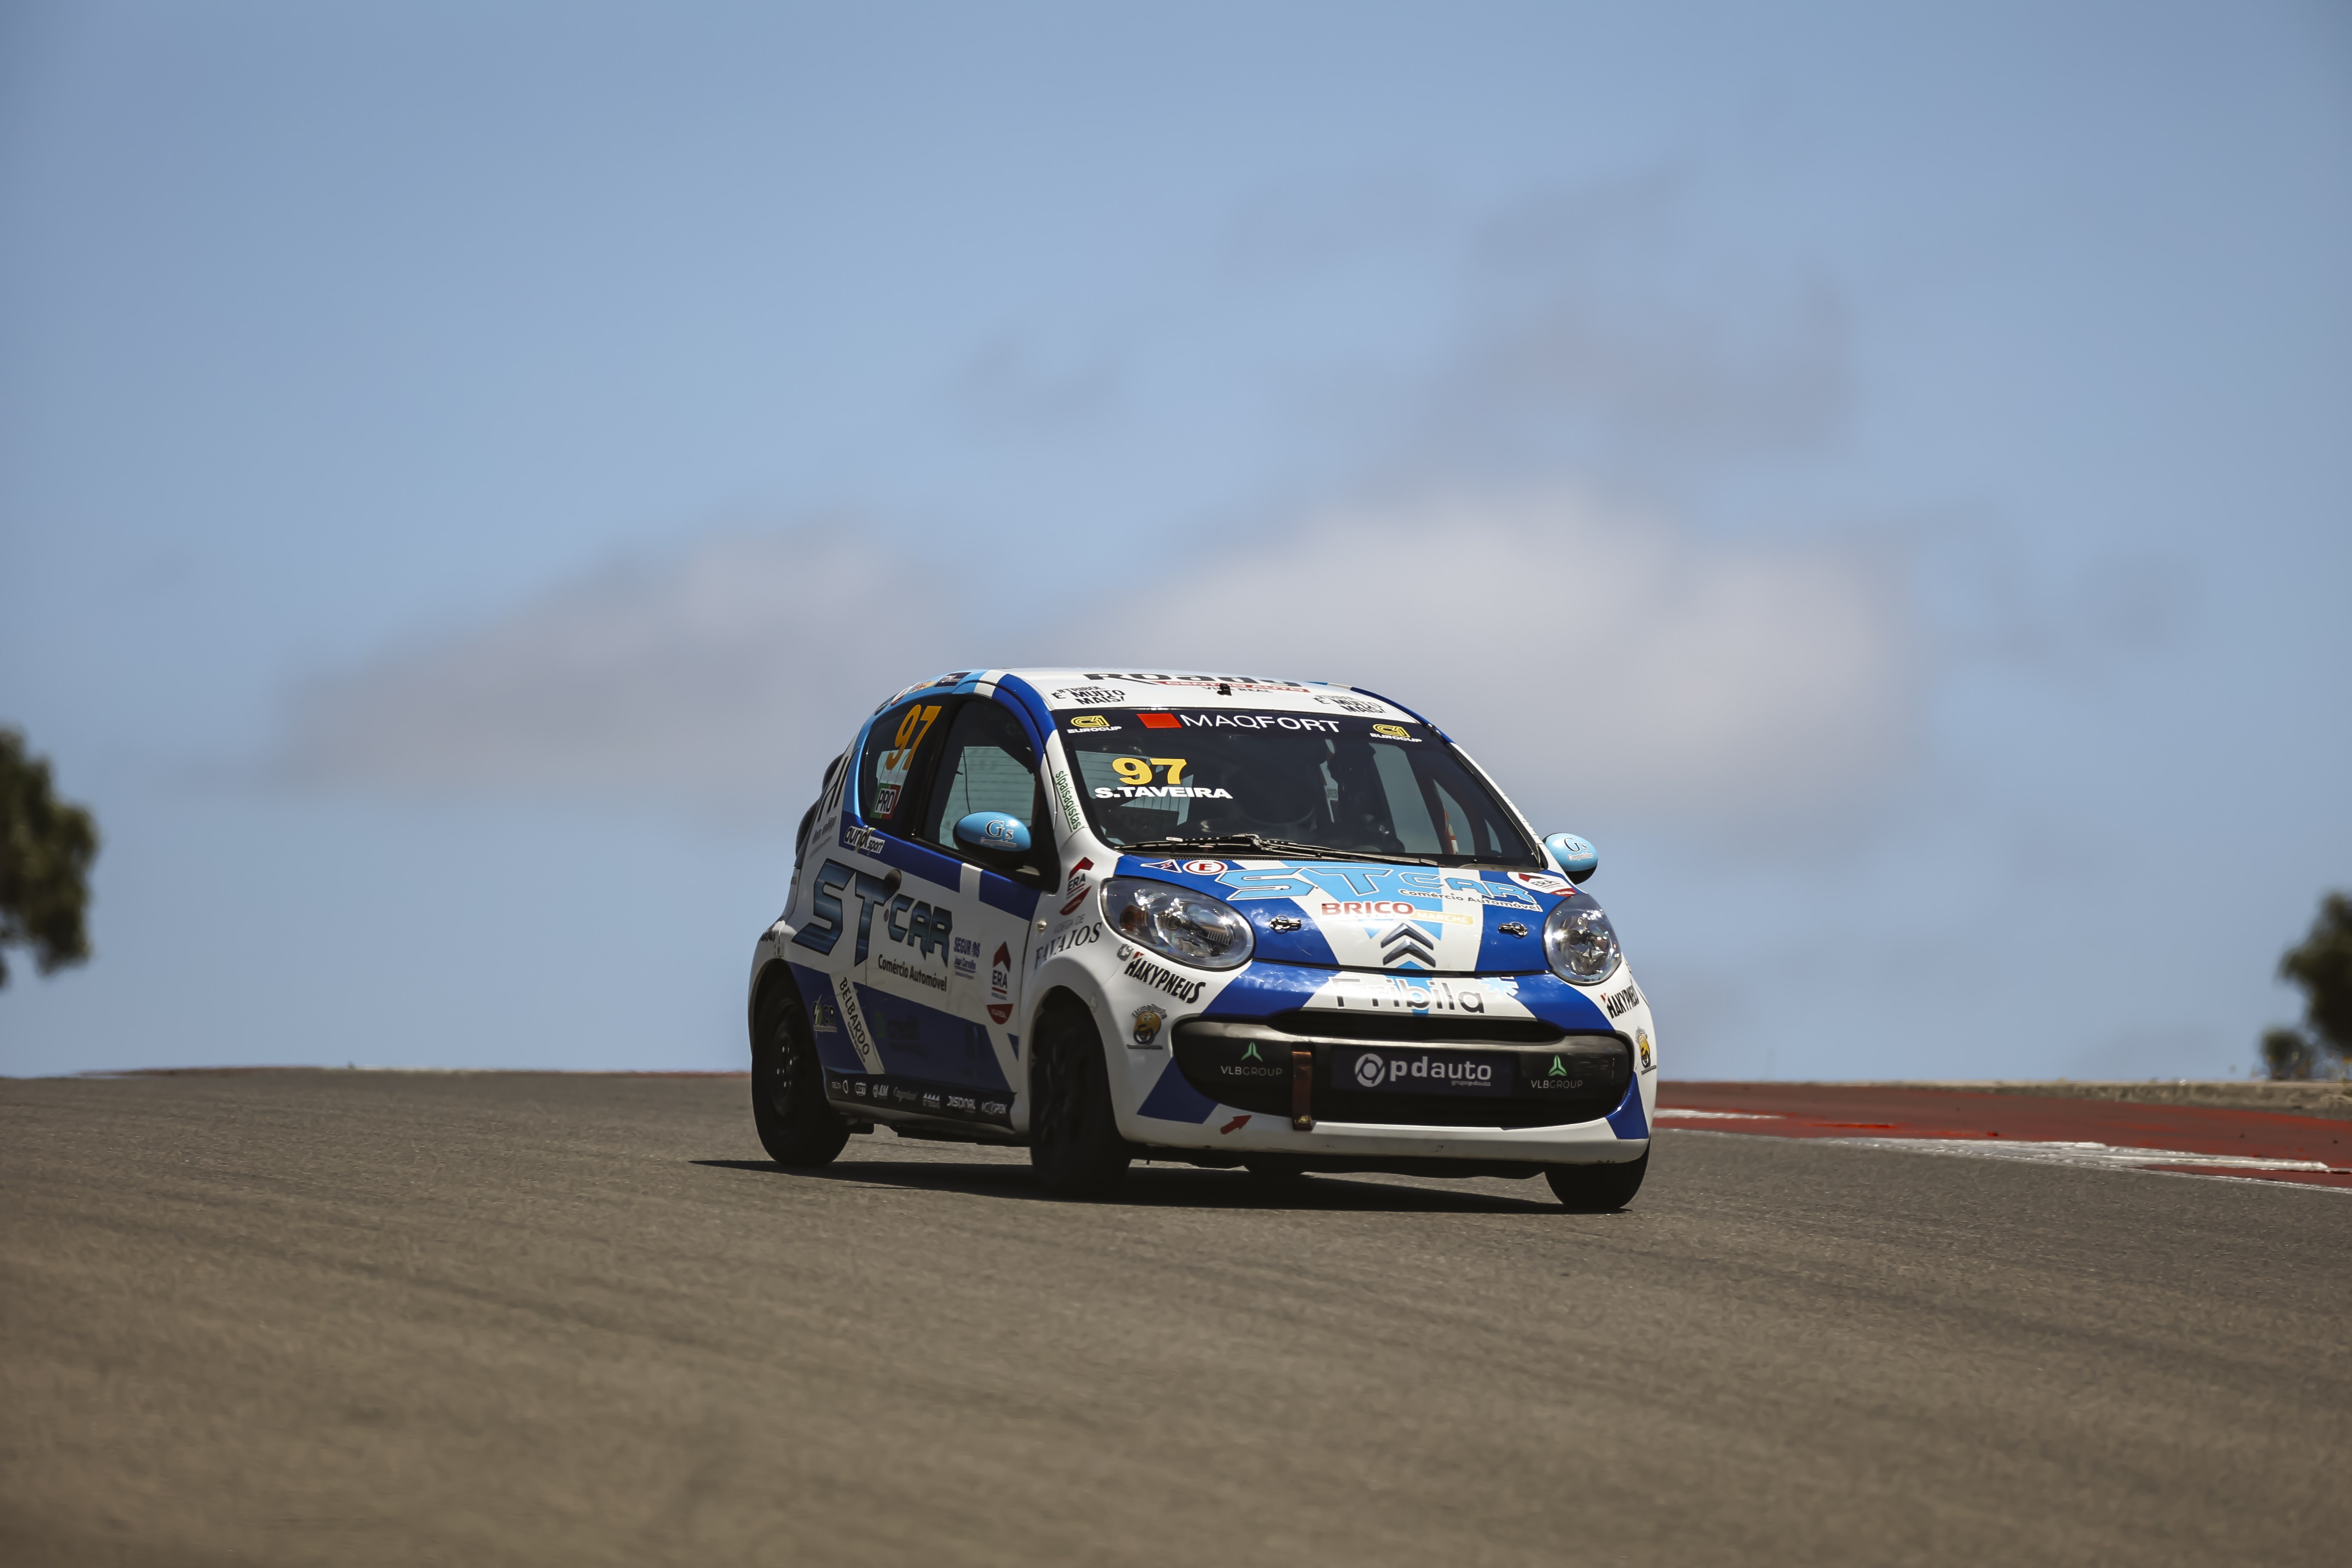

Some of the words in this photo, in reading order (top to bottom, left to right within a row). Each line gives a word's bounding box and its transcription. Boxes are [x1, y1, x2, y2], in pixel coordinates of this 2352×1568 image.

[1071, 689, 1126, 698] MUITO
[1075, 696, 1125, 705] MAIS!
[1179, 714, 1339, 732] MAQFORT
[886, 704, 942, 770] 97
[1369, 733, 1422, 742] EUROCUP
[1111, 757, 1187, 785] 97
[875, 790, 895, 812] PRO
[1094, 787, 1234, 799] S.TAVEIRA
[1067, 873, 1086, 892] ERA
[1531, 878, 1557, 887] ERA
[1321, 901, 1414, 916] BRICO
[1399, 888, 1466, 901] Comércio
[1467, 895, 1541, 911] Automóvel
[1034, 922, 1103, 970] FAVAIOS
[878, 953, 909, 979] Comércio
[910, 965, 947, 992] Automóvel
[992, 969, 1008, 989] ERA
[1124, 958, 1207, 1004] HAKYPNEUS
[839, 977, 870, 1055] BELBARDO
[1220, 1066, 1283, 1076] VLBGROUP
[1390, 1056, 1491, 1081] pdauto
[1531, 1080, 1583, 1088] VLBGROUP
